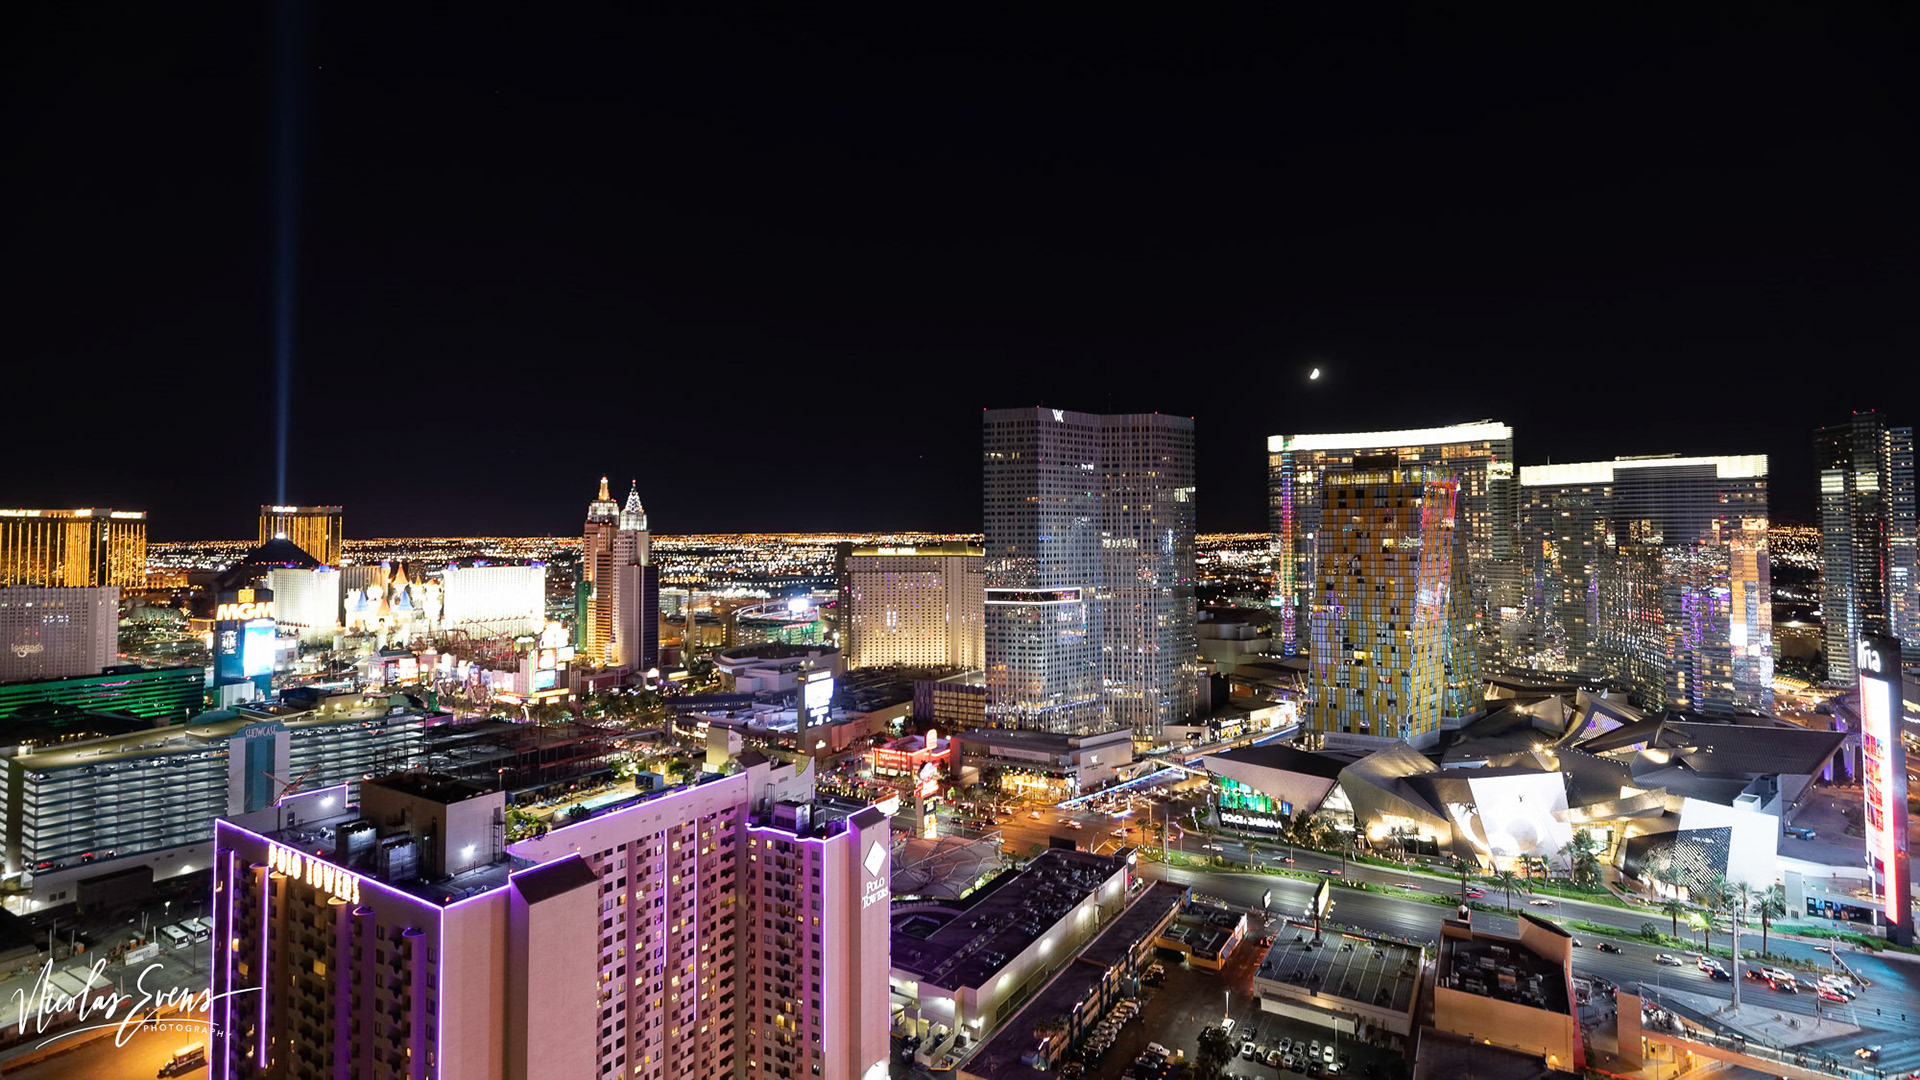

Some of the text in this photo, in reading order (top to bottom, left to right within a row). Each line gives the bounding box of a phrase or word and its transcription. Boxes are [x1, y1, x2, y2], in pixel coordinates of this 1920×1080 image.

[216, 602, 275, 620] MGM
[246, 725, 277, 739] SHOWCASE
[268, 842, 360, 905] POLO TOWERS
